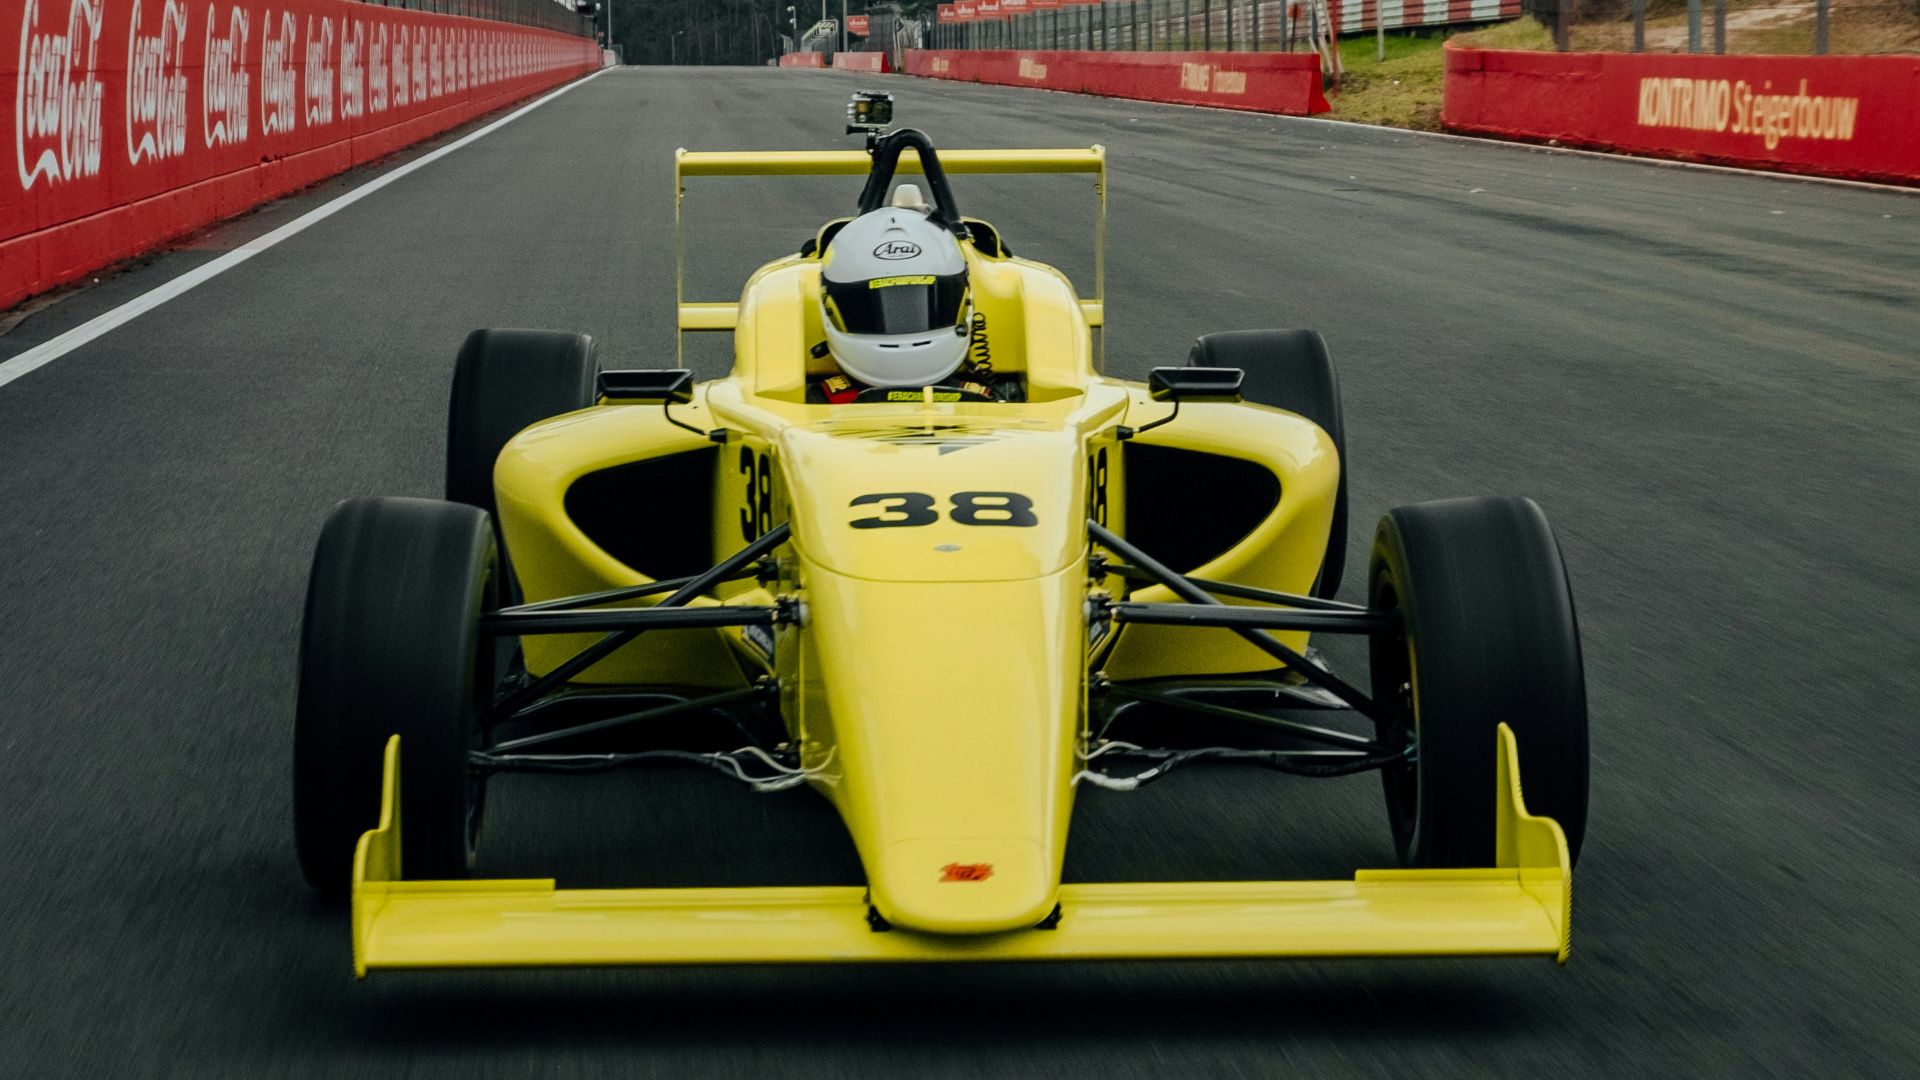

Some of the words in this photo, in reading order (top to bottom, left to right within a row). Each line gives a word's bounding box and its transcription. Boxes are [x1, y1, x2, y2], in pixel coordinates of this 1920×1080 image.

[1638, 77, 1730, 132] KONTRIMO
[1732, 79, 1858, 150] Steigerbouw
[876, 243, 915, 256] Arai
[740, 445, 772, 544] 38
[849, 491, 1038, 529] 38
